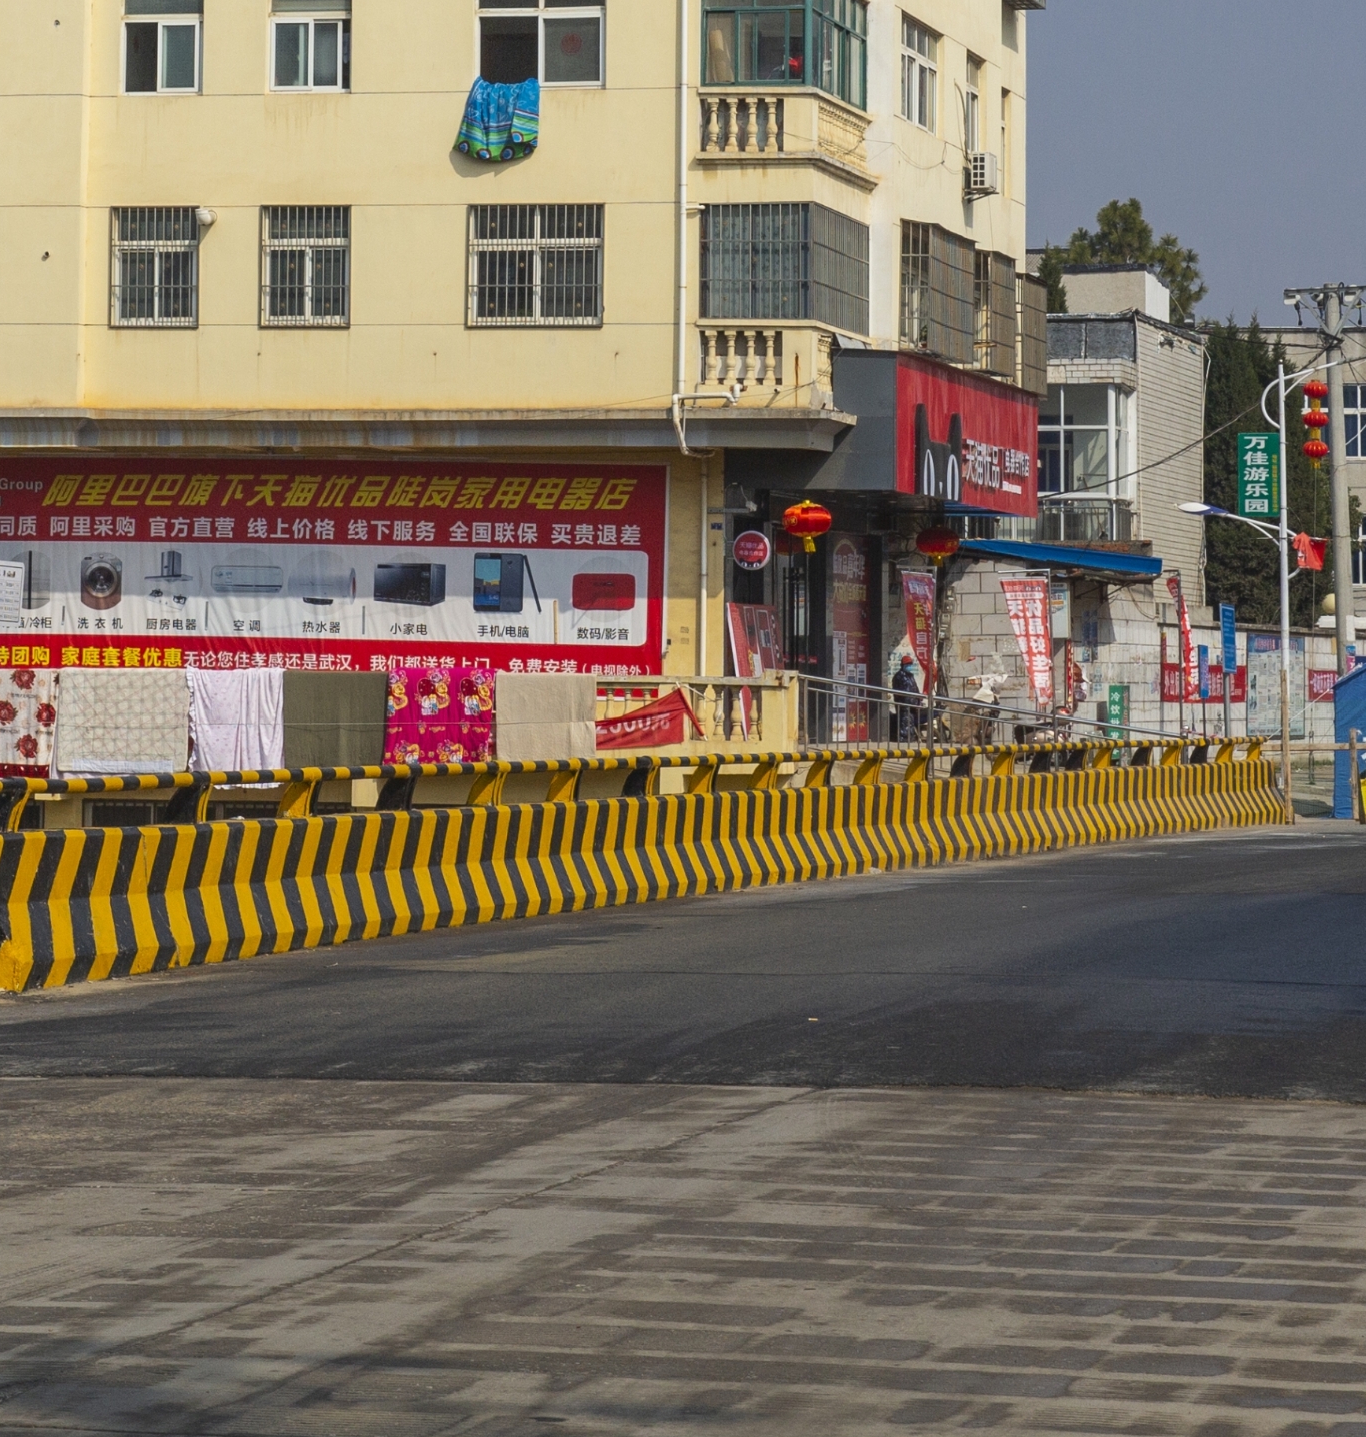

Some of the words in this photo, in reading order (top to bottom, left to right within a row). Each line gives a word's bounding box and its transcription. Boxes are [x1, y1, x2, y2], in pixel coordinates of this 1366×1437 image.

[1243, 436, 1269, 513] 万佳游乐园
[42, 474, 638, 510] 阿里巴巴旗下天猫优品陡岗家用电器店
[50, 516, 136, 537] 阿里采购
[149, 517, 235, 538] 官方直营
[247, 518, 335, 540] 线上价格
[347, 519, 436, 542] 线下服务
[449, 521, 538, 543] 全国联保
[550, 523, 641, 545] 买贵退差
[77, 617, 124, 630] 洗衣机
[146, 618, 197, 631] 厨房电器
[233, 620, 261, 632] 空调
[302, 620, 341, 634] 热水器
[390, 623, 428, 636] 小家电
[477, 625, 530, 639] 手机/电脑
[577, 627, 630, 641] 数码/影音
[61, 647, 182, 667] 家庭套餐优惠
